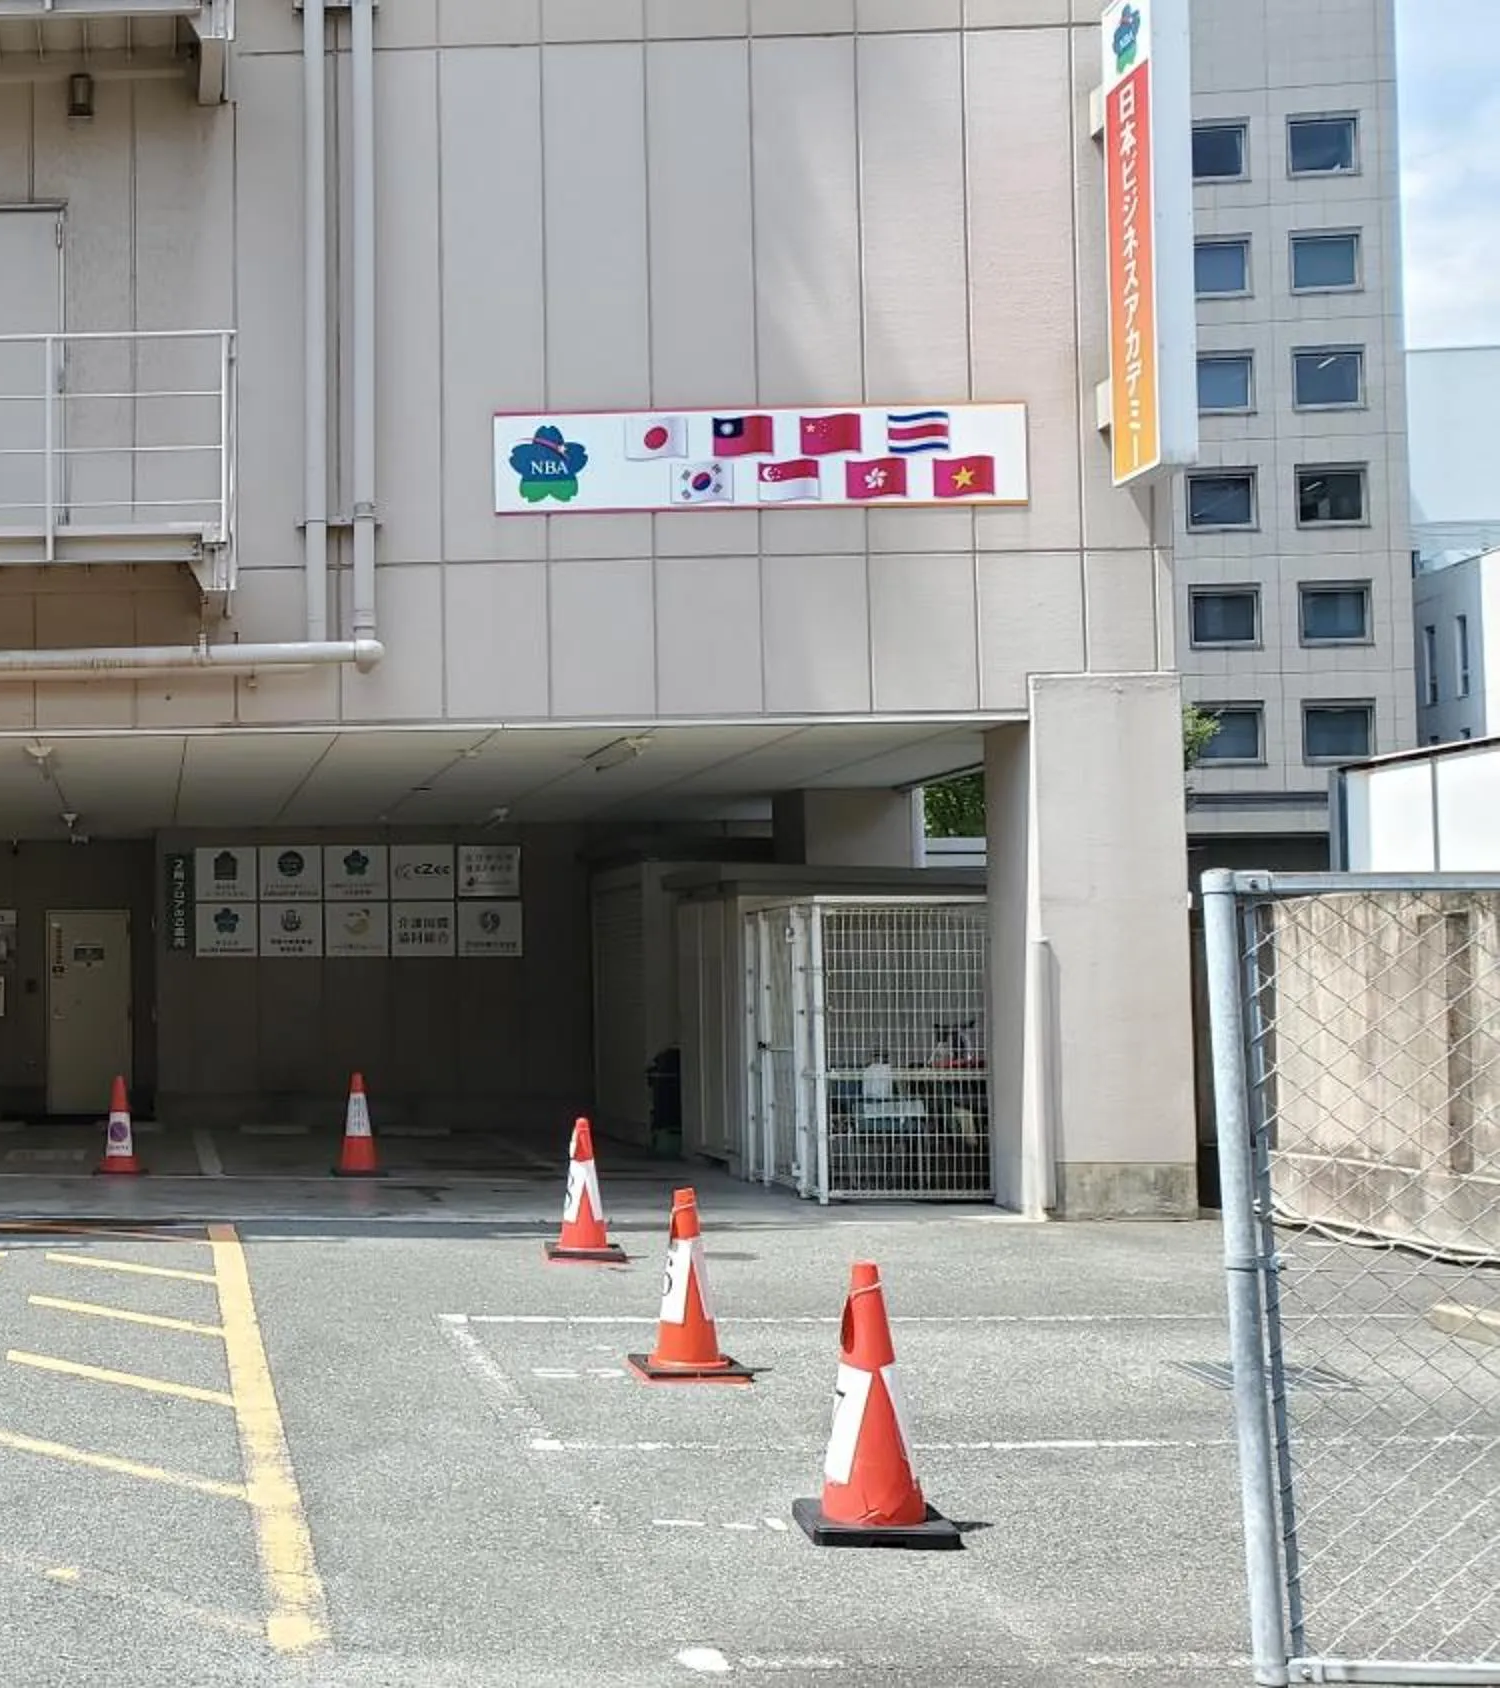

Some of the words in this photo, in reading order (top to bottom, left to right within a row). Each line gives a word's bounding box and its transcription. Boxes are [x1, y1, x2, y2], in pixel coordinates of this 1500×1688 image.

[1117, 78, 1142, 467] 日本ビジネスアカデミー
[530, 460, 568, 476] NBA
